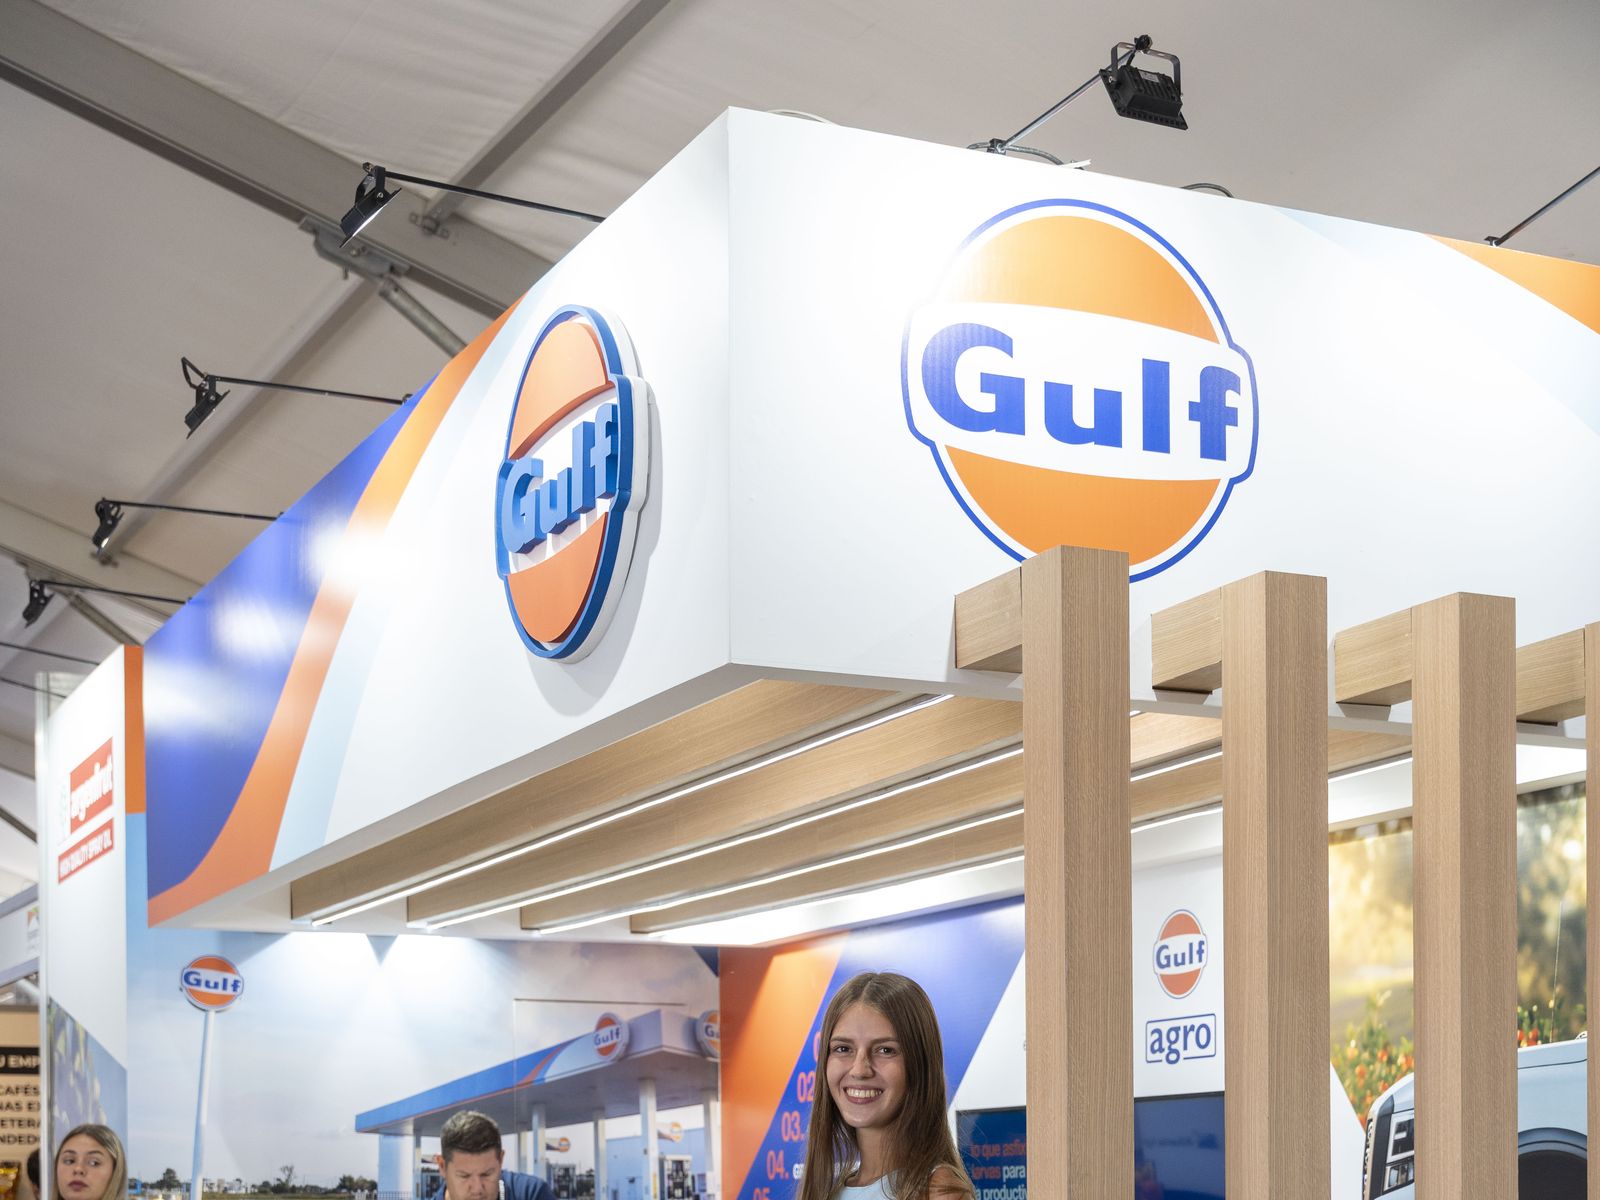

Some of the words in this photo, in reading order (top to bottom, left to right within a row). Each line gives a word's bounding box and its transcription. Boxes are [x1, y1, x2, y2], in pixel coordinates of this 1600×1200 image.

[921, 322, 1241, 462] Gulf
[502, 403, 618, 553] Gulf
[1156, 940, 1205, 969] Gulf
[184, 971, 241, 992] Gulf
[593, 1027, 620, 1046] Gulf
[1150, 1023, 1211, 1065] agro
[1003, 1165, 1026, 1182] para
